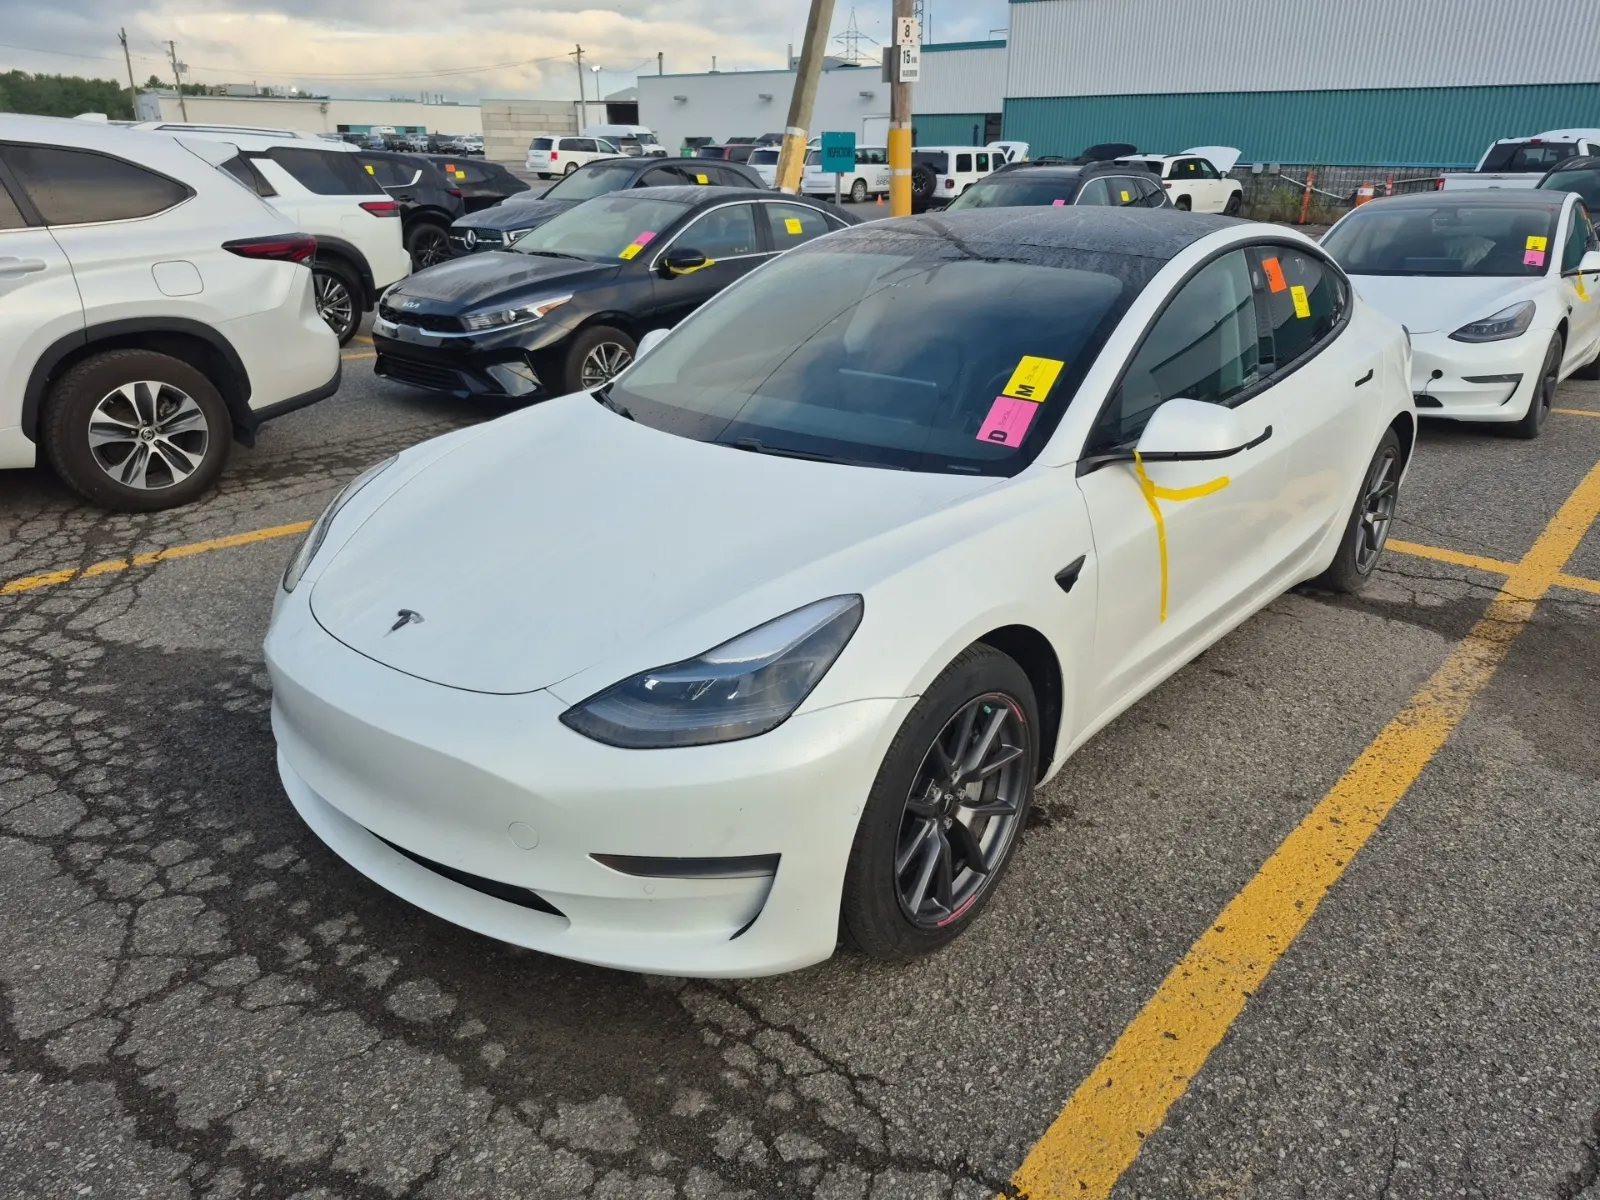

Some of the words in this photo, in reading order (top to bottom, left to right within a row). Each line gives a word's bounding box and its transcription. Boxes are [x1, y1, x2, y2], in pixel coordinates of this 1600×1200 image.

[904, 24, 911, 38] 8
[902, 50, 911, 64] 15
[1014, 384, 1036, 397] M
[987, 429, 1008, 442] D
